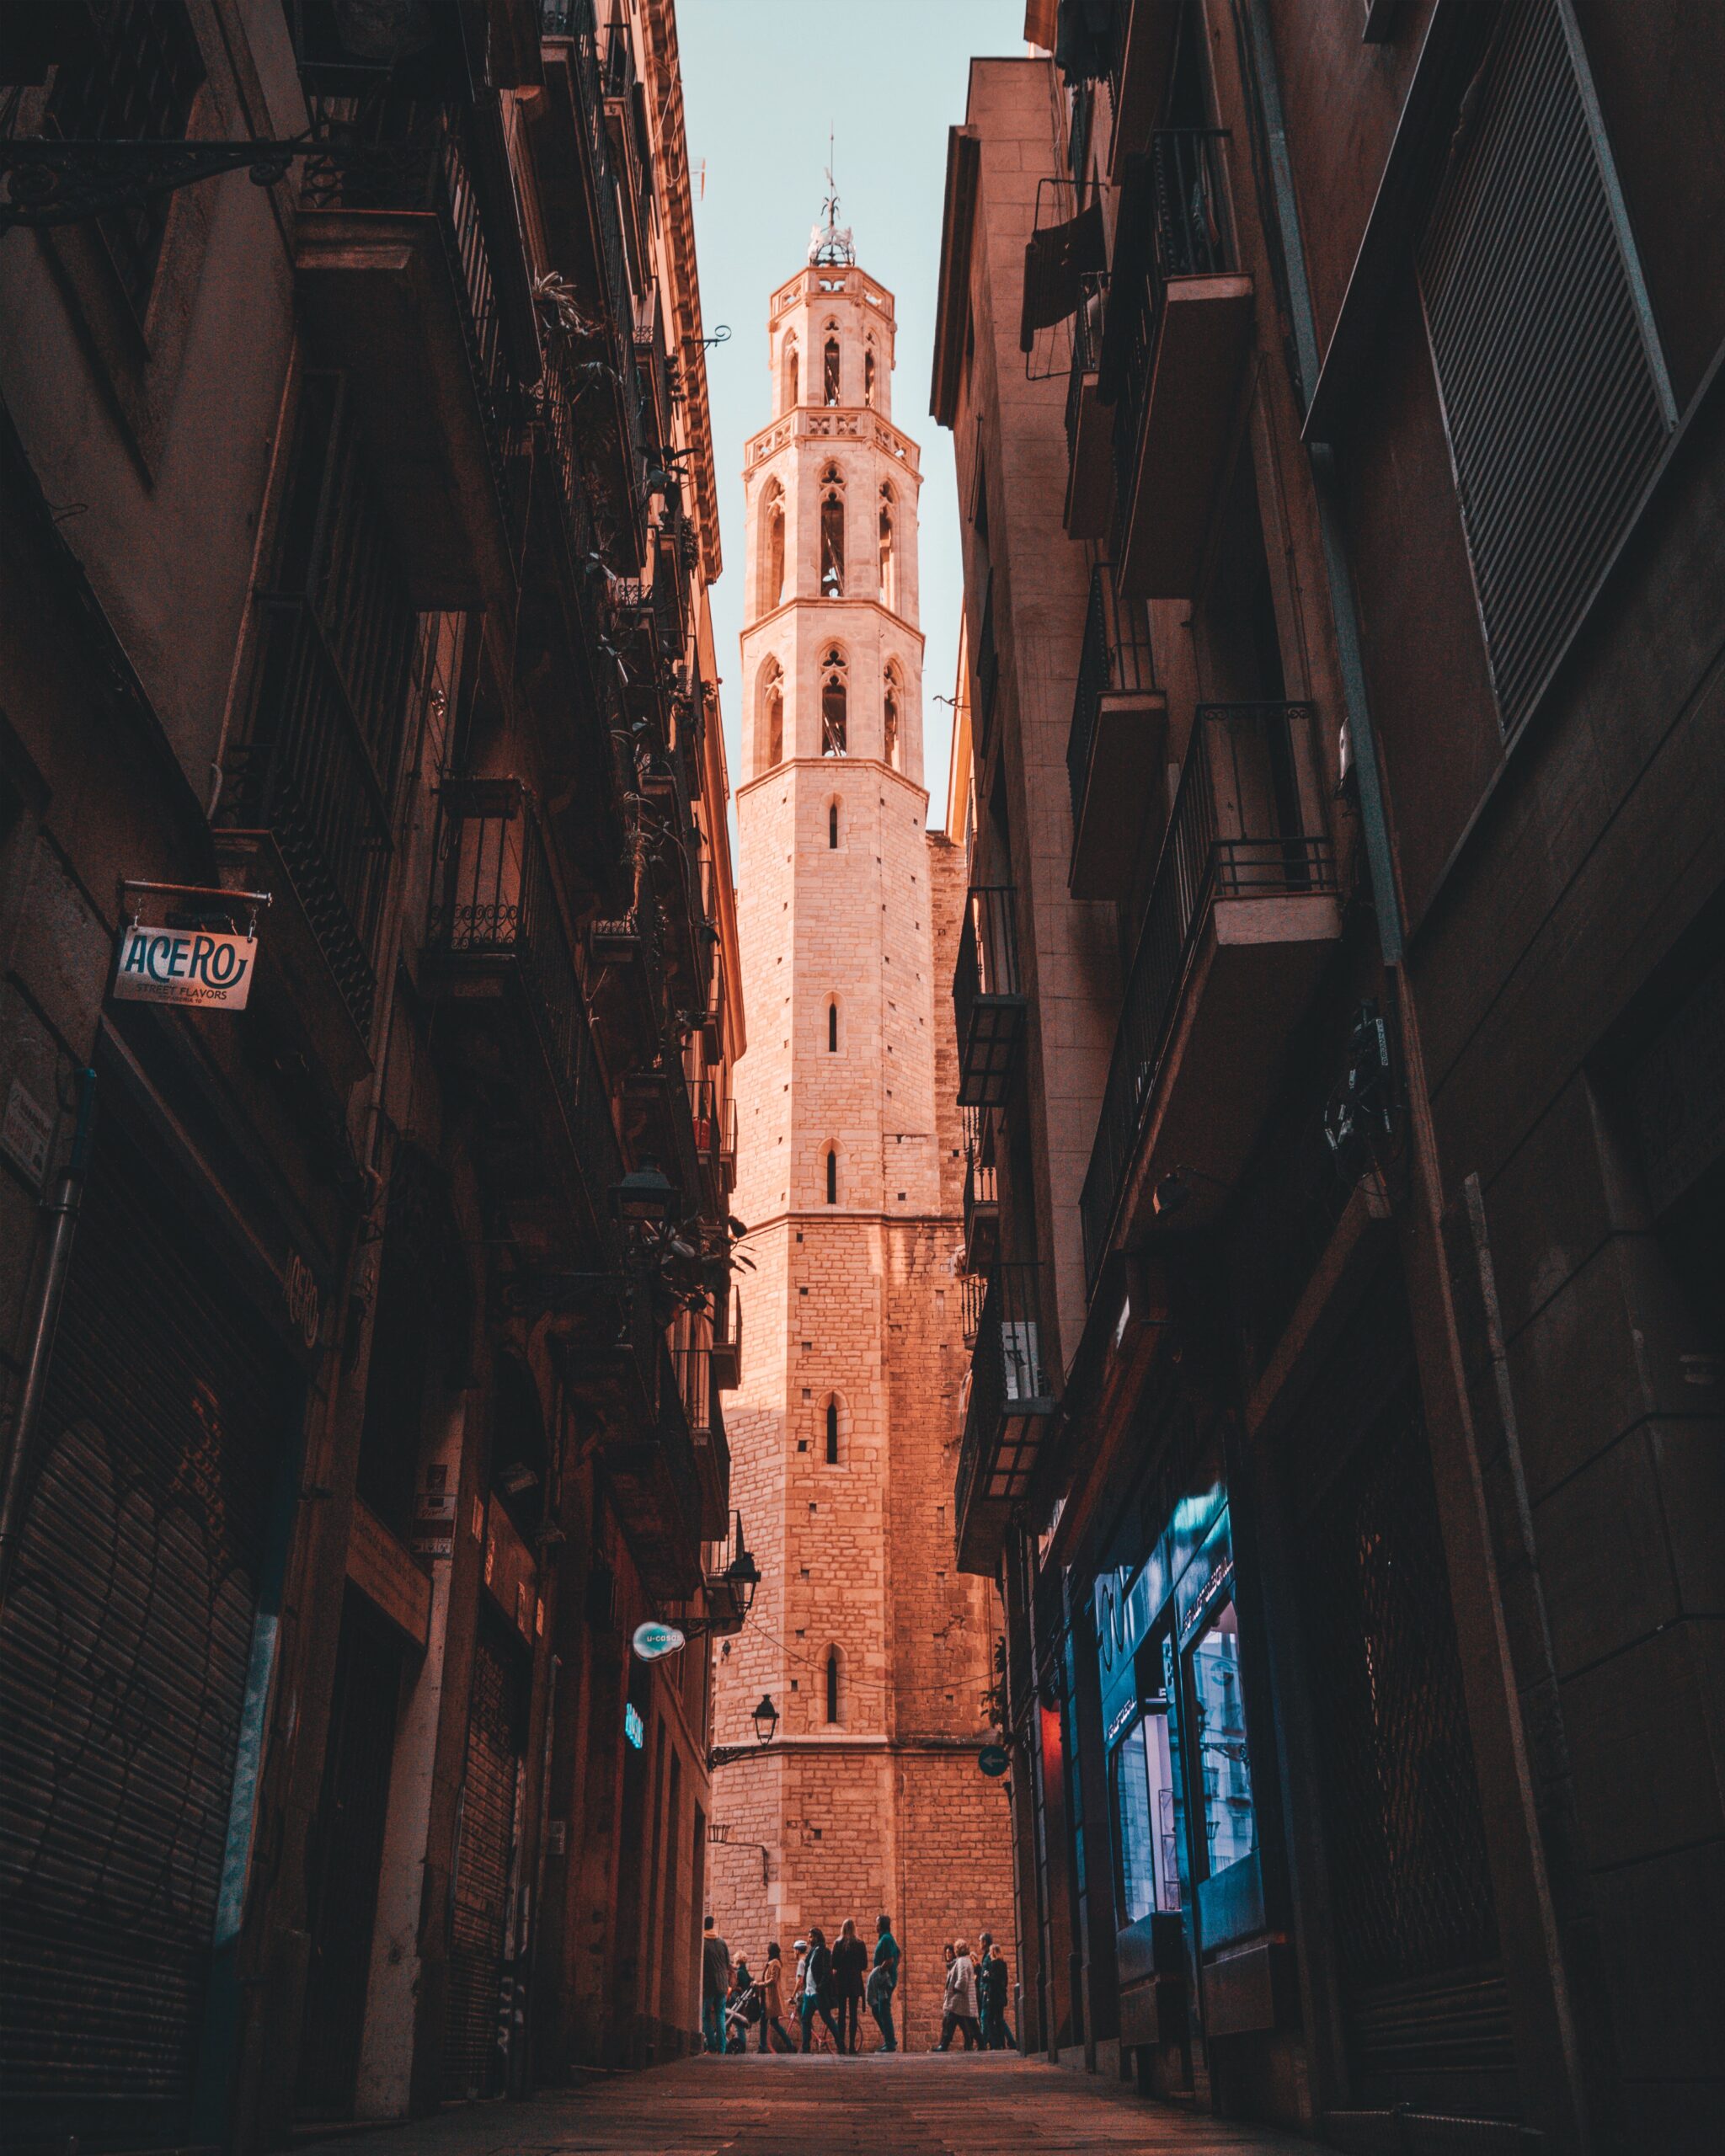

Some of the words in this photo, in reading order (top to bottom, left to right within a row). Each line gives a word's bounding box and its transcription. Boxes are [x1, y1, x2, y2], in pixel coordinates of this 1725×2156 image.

[126, 935, 248, 989] ACERO
[136, 983, 176, 995] STREET
[179, 987, 227, 1001] FLAVORS
